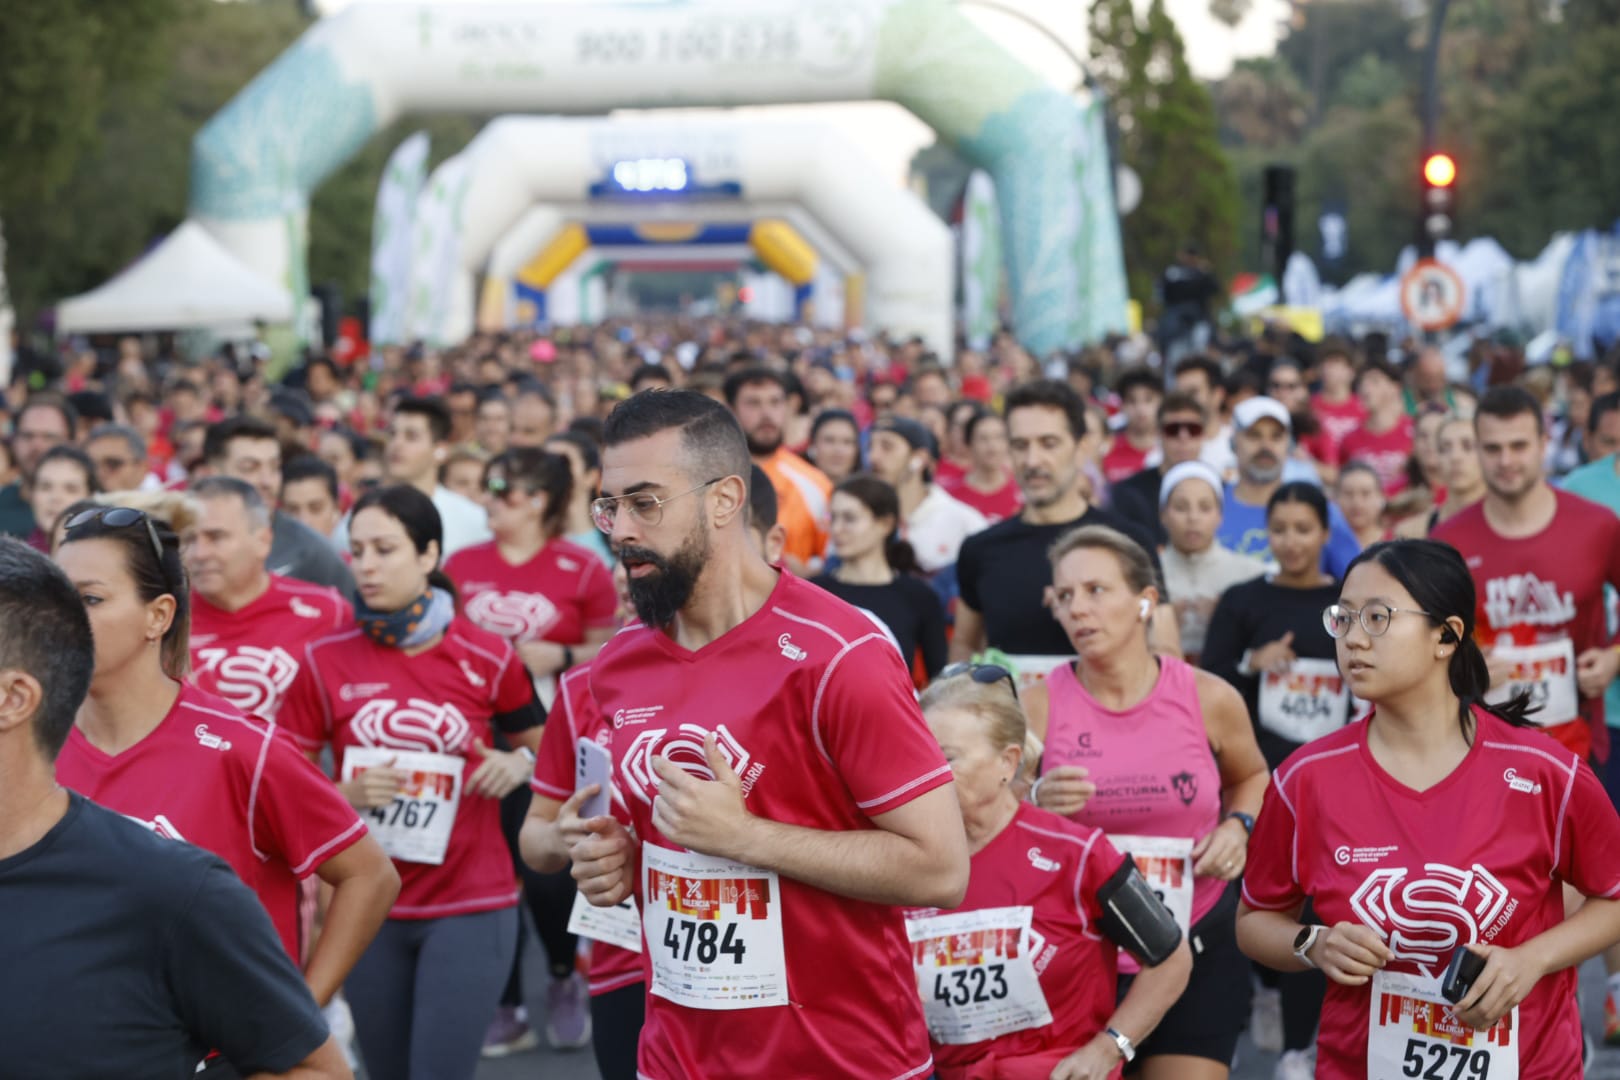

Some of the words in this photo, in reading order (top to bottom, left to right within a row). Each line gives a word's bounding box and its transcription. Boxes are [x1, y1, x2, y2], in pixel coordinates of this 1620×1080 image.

[1095, 785, 1168, 798] NOCTURNA
[369, 798, 438, 829] 4767
[1485, 898, 1519, 940] SOLIDARIA
[663, 917, 746, 964] 4784
[934, 963, 1008, 1007] 4323
[1434, 1022, 1465, 1035] VALENCIA
[1402, 1038, 1491, 1080] 5279
